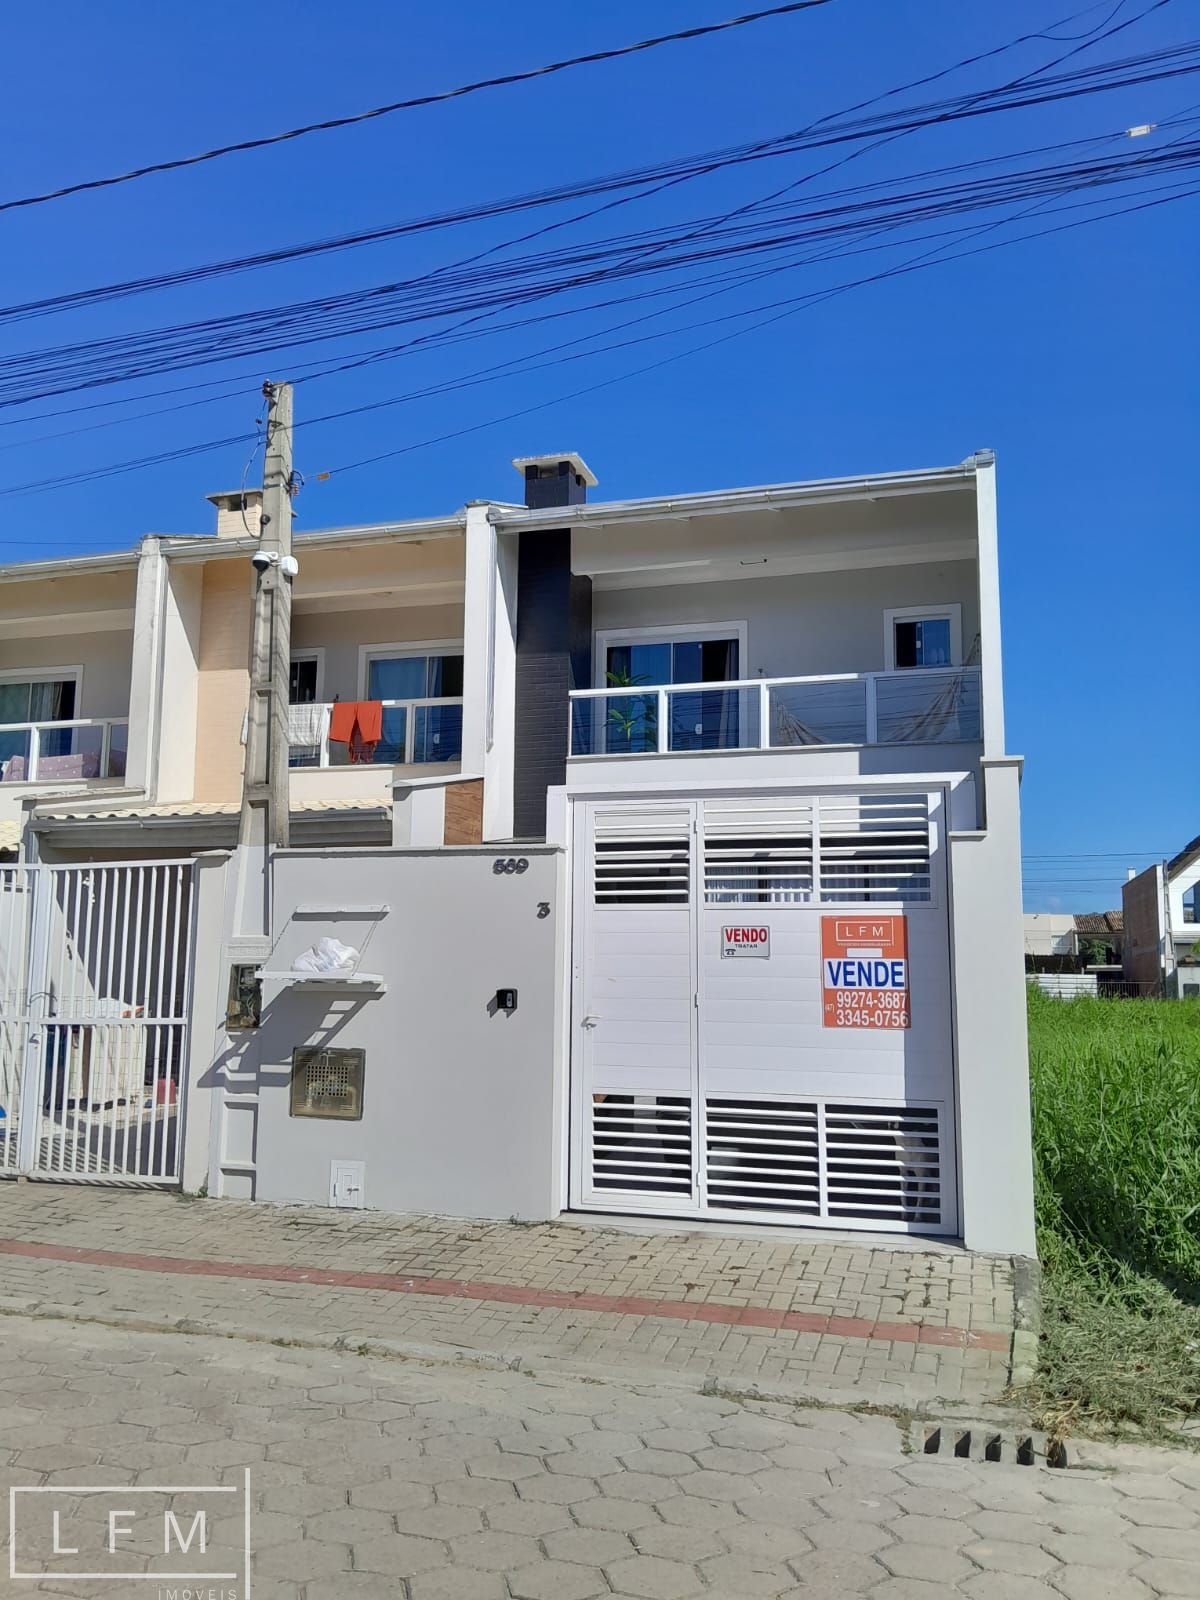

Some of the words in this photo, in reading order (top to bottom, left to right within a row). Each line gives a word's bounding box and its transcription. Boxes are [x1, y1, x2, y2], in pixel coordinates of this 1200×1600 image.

[536, 902, 551, 919] 3
[725, 928, 768, 943] VENDO
[827, 961, 905, 987] VENDE
[836, 991, 907, 1009] 99274-3687
[836, 1009, 909, 1026] 3345-0756
